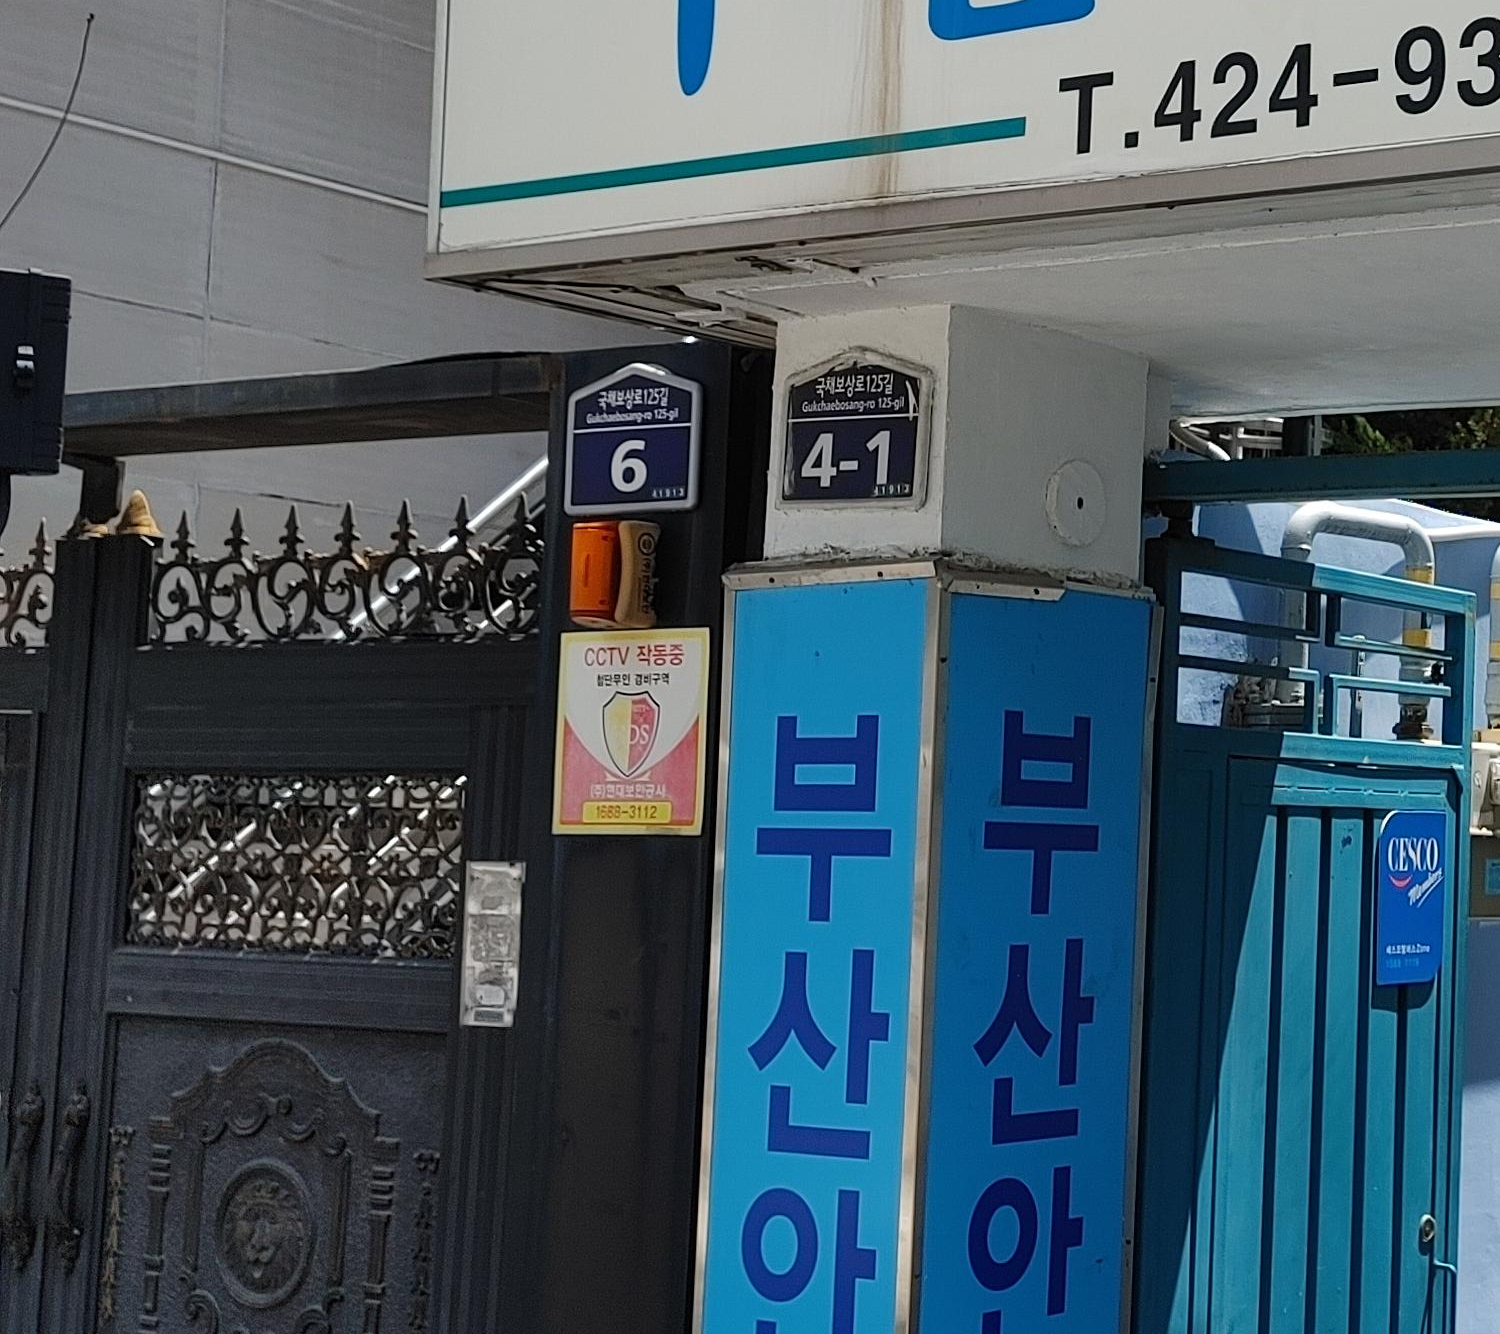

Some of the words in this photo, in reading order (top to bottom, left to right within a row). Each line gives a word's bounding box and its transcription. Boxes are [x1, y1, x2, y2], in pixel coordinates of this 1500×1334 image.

[815, 373, 894, 398] 국채보상로125길
[654, 408, 679, 421] 125-gil
[802, 400, 876, 413] Gukchaebosang-ro
[878, 396, 905, 411] 125-gil
[611, 439, 648, 493] 6
[801, 430, 891, 488] 4-1
[584, 646, 630, 667] CCTV
[636, 644, 685, 666] 작동중
[634, 673, 670, 686] 경비구역
[1387, 836, 1439, 872] CESCO
